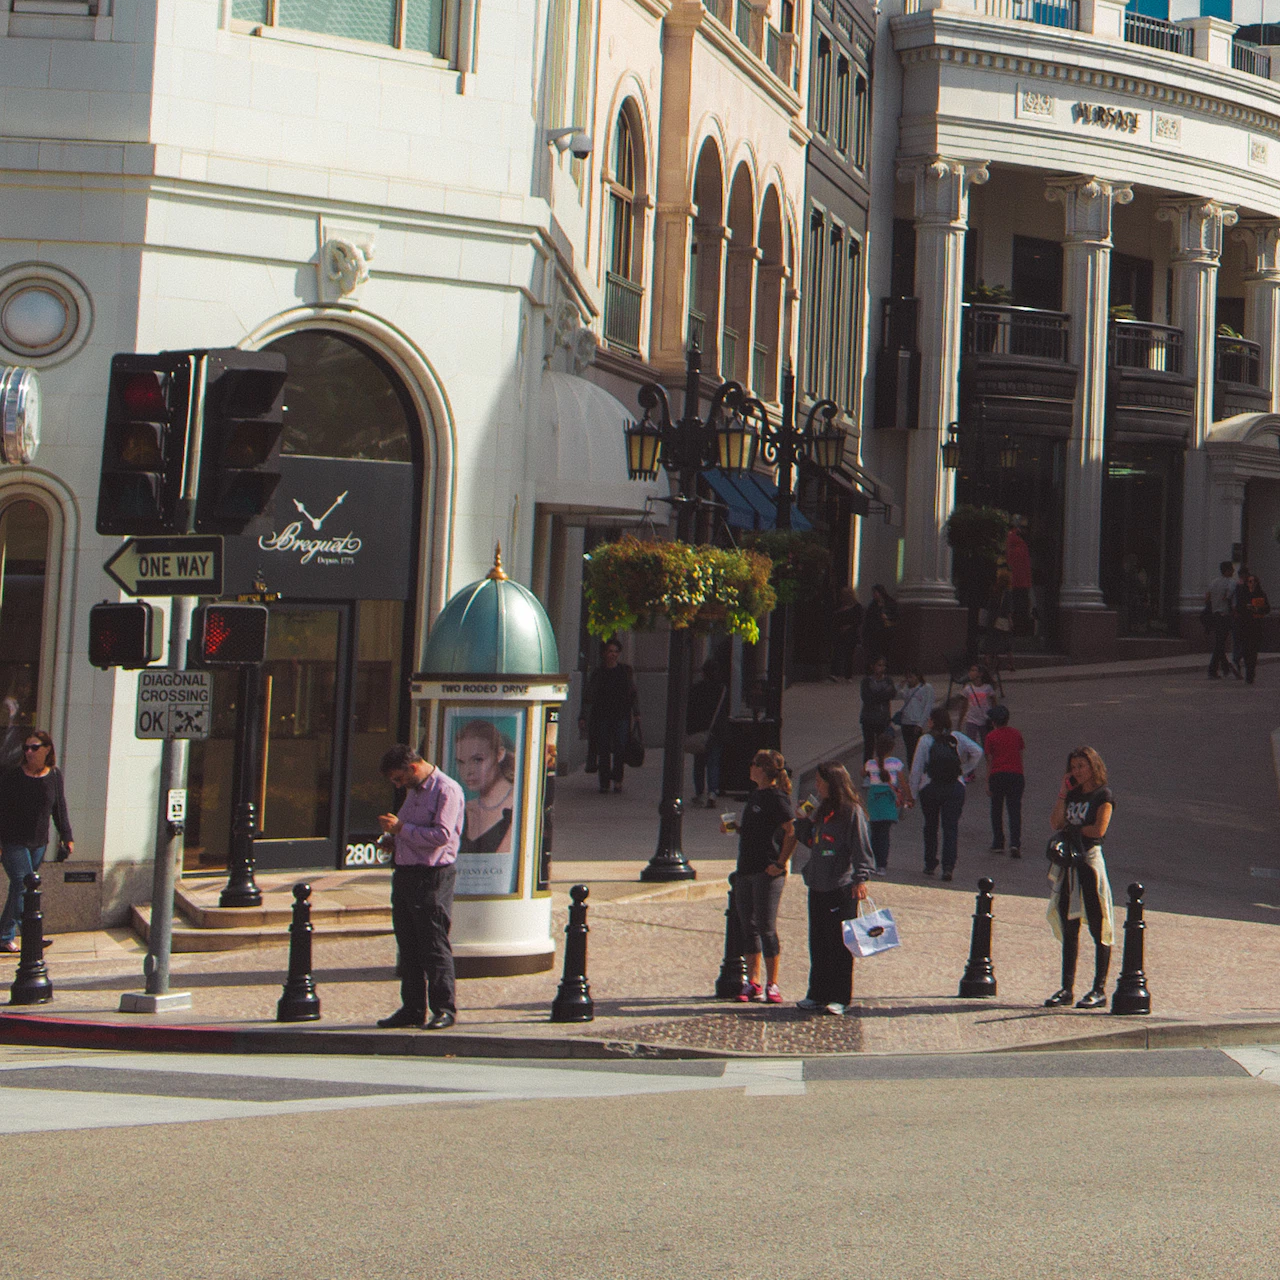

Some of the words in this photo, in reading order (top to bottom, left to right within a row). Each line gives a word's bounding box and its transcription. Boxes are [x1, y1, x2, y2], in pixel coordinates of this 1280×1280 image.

[258, 521, 362, 565] Breguet
[138, 556, 171, 578] ONE
[177, 555, 210, 577] WAY
[142, 673, 208, 687] DIAGONAL
[441, 684, 461, 693] TWO
[462, 684, 498, 693] RODEO
[502, 684, 529, 693] DRIVE
[140, 689, 209, 703] CROSSING
[139, 710, 165, 733] OK
[345, 843, 376, 866] 280
